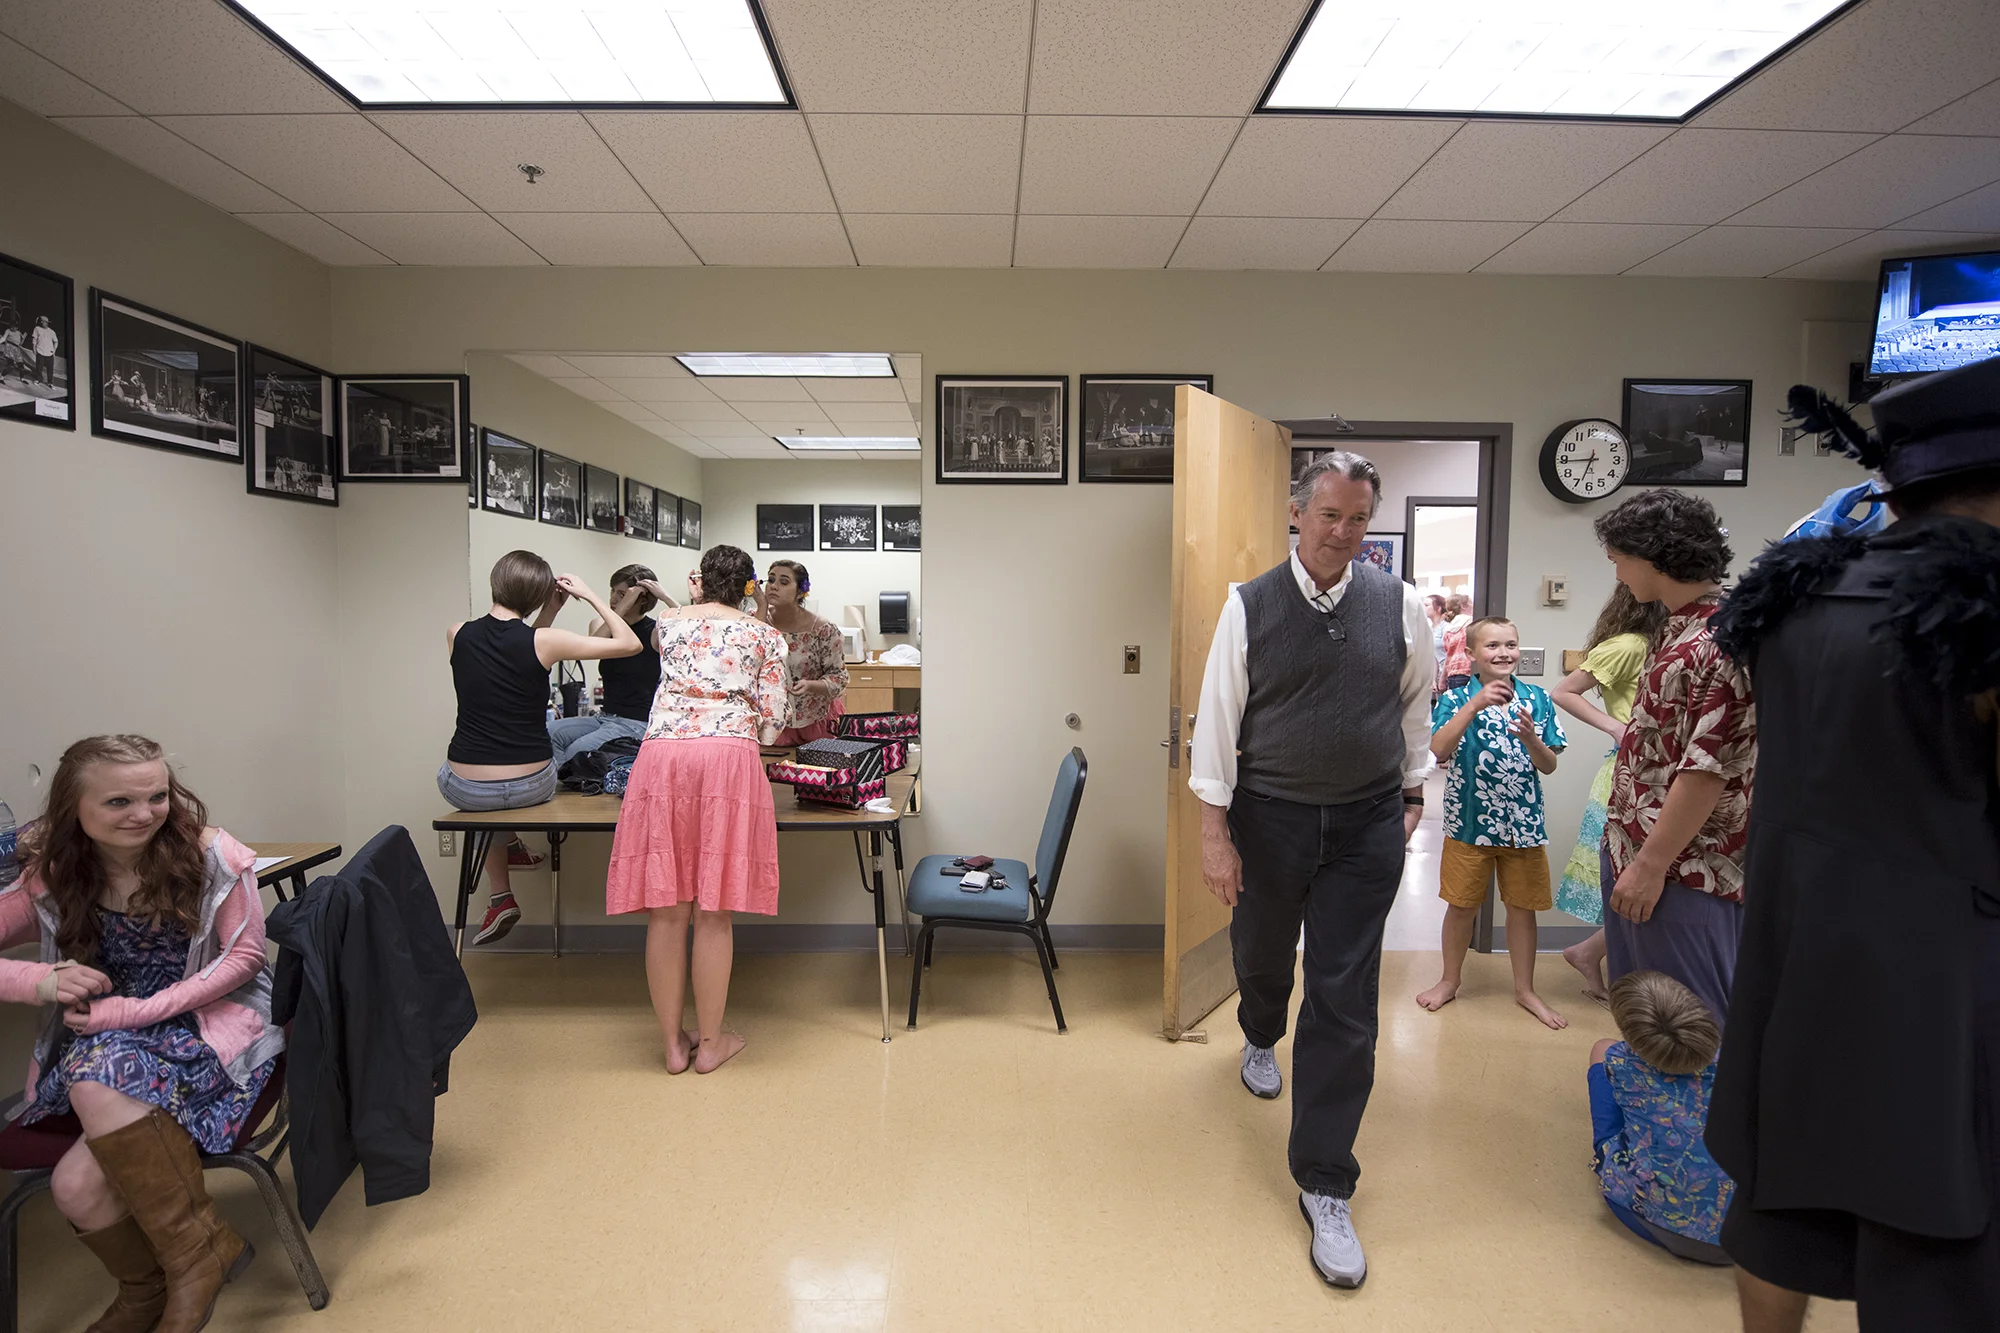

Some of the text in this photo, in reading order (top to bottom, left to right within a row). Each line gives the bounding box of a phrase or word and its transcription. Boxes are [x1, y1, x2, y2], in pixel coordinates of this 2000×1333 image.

[1576, 432, 1583, 441] 11
[1564, 443, 1575, 452] 10
[1610, 443, 1618, 452] 2
[1560, 455, 1568, 464] 9
[1612, 456, 1620, 465] 3
[1564, 469, 1572, 478] 8
[1607, 469, 1615, 478] 4
[1573, 478, 1580, 487] 7
[1585, 482, 1593, 491] 6
[1597, 478, 1605, 487] 5
